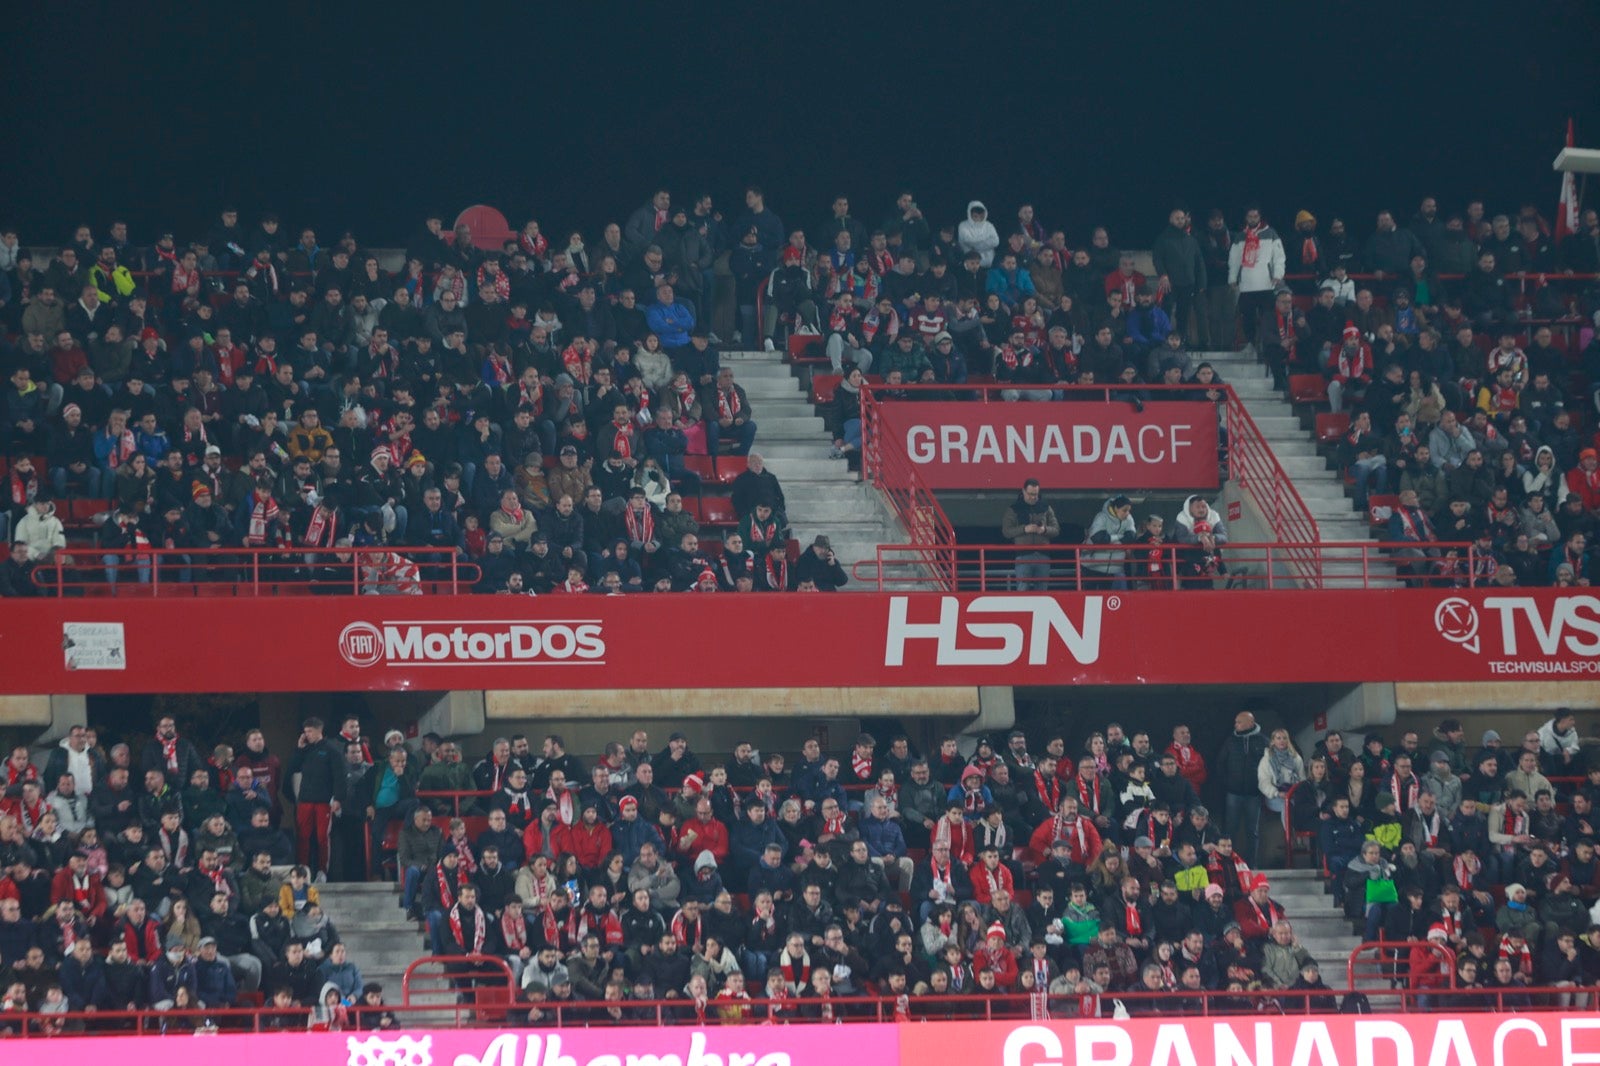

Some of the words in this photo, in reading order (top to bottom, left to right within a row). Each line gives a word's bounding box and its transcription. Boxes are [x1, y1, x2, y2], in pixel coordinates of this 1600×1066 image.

[350, 635, 373, 654] FIAT
[384, 624, 606, 660] MotorDOS
[885, 596, 1103, 667] HSN
[1483, 595, 1600, 657] TVS
